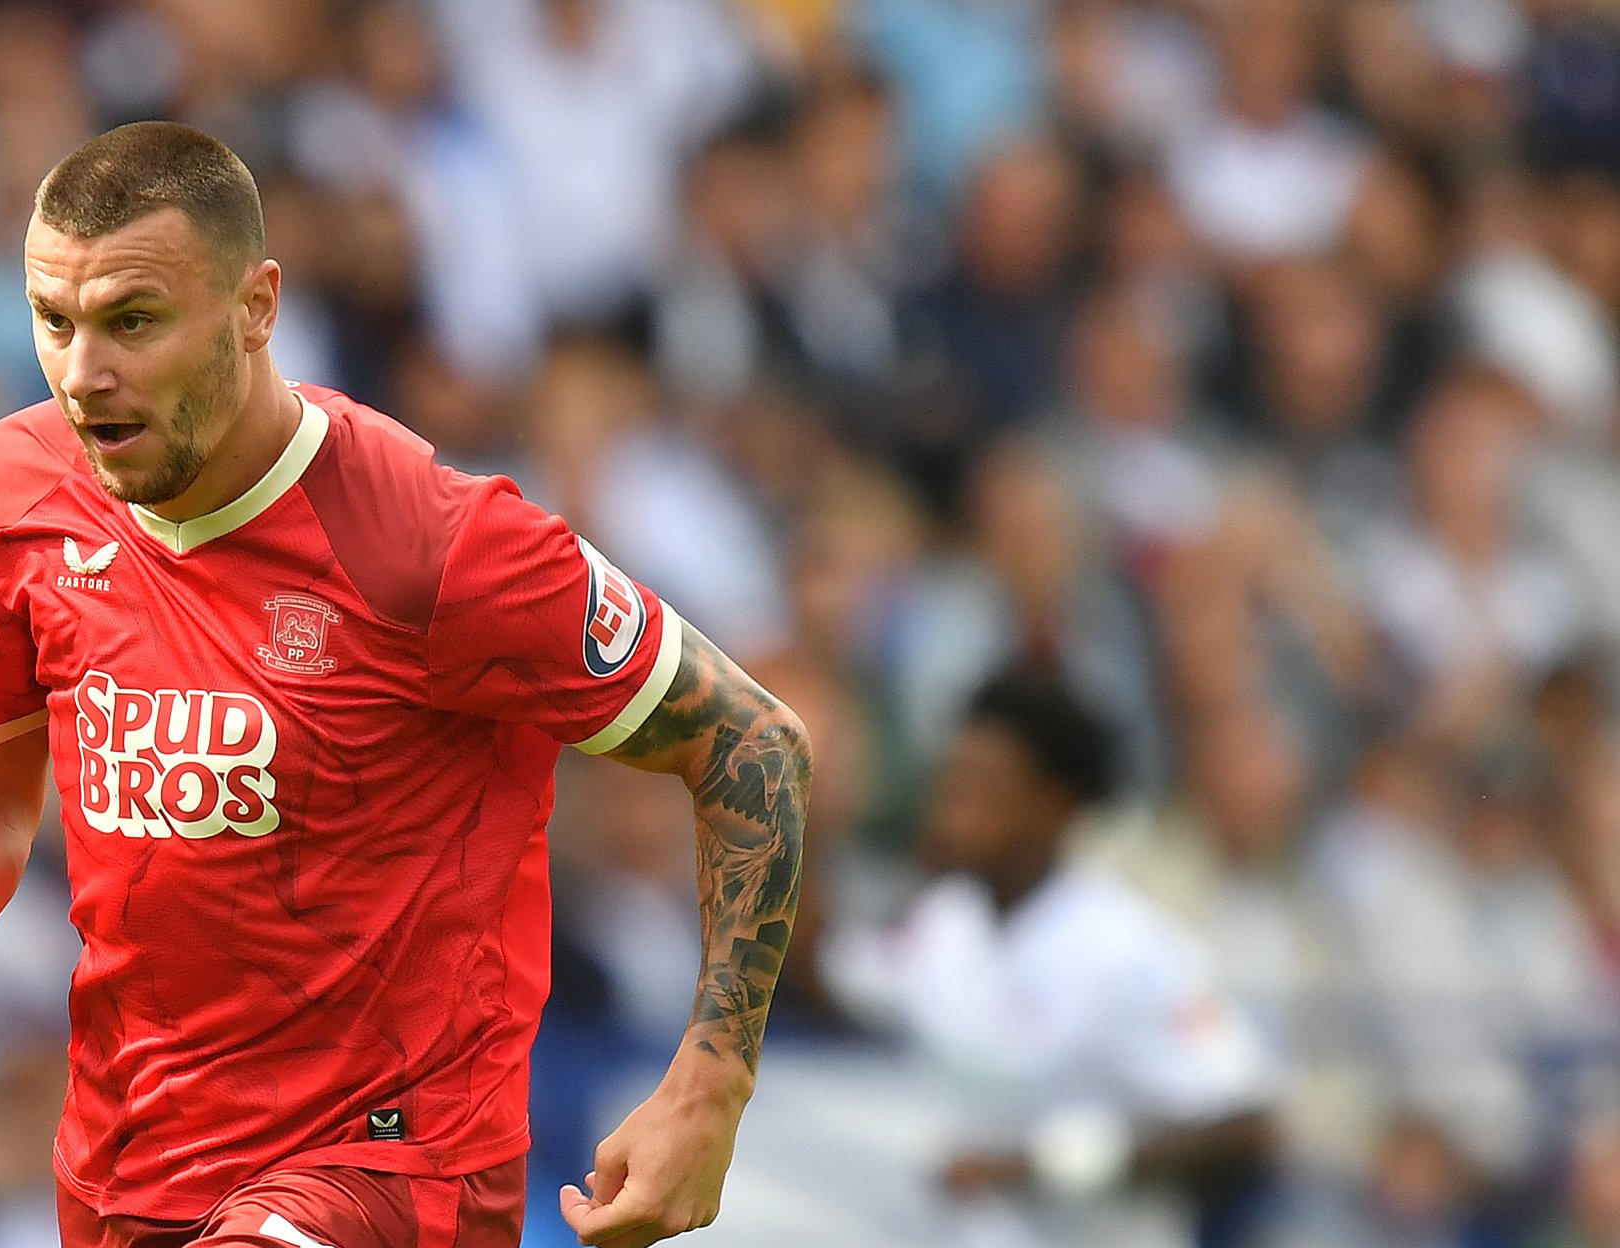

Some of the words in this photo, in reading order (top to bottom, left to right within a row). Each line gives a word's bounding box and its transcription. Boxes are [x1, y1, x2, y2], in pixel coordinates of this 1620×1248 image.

[56, 575, 112, 592] CASTORE
[287, 648, 305, 661] PP
[75, 670, 277, 766] SPUD
[78, 748, 280, 838] BROS
